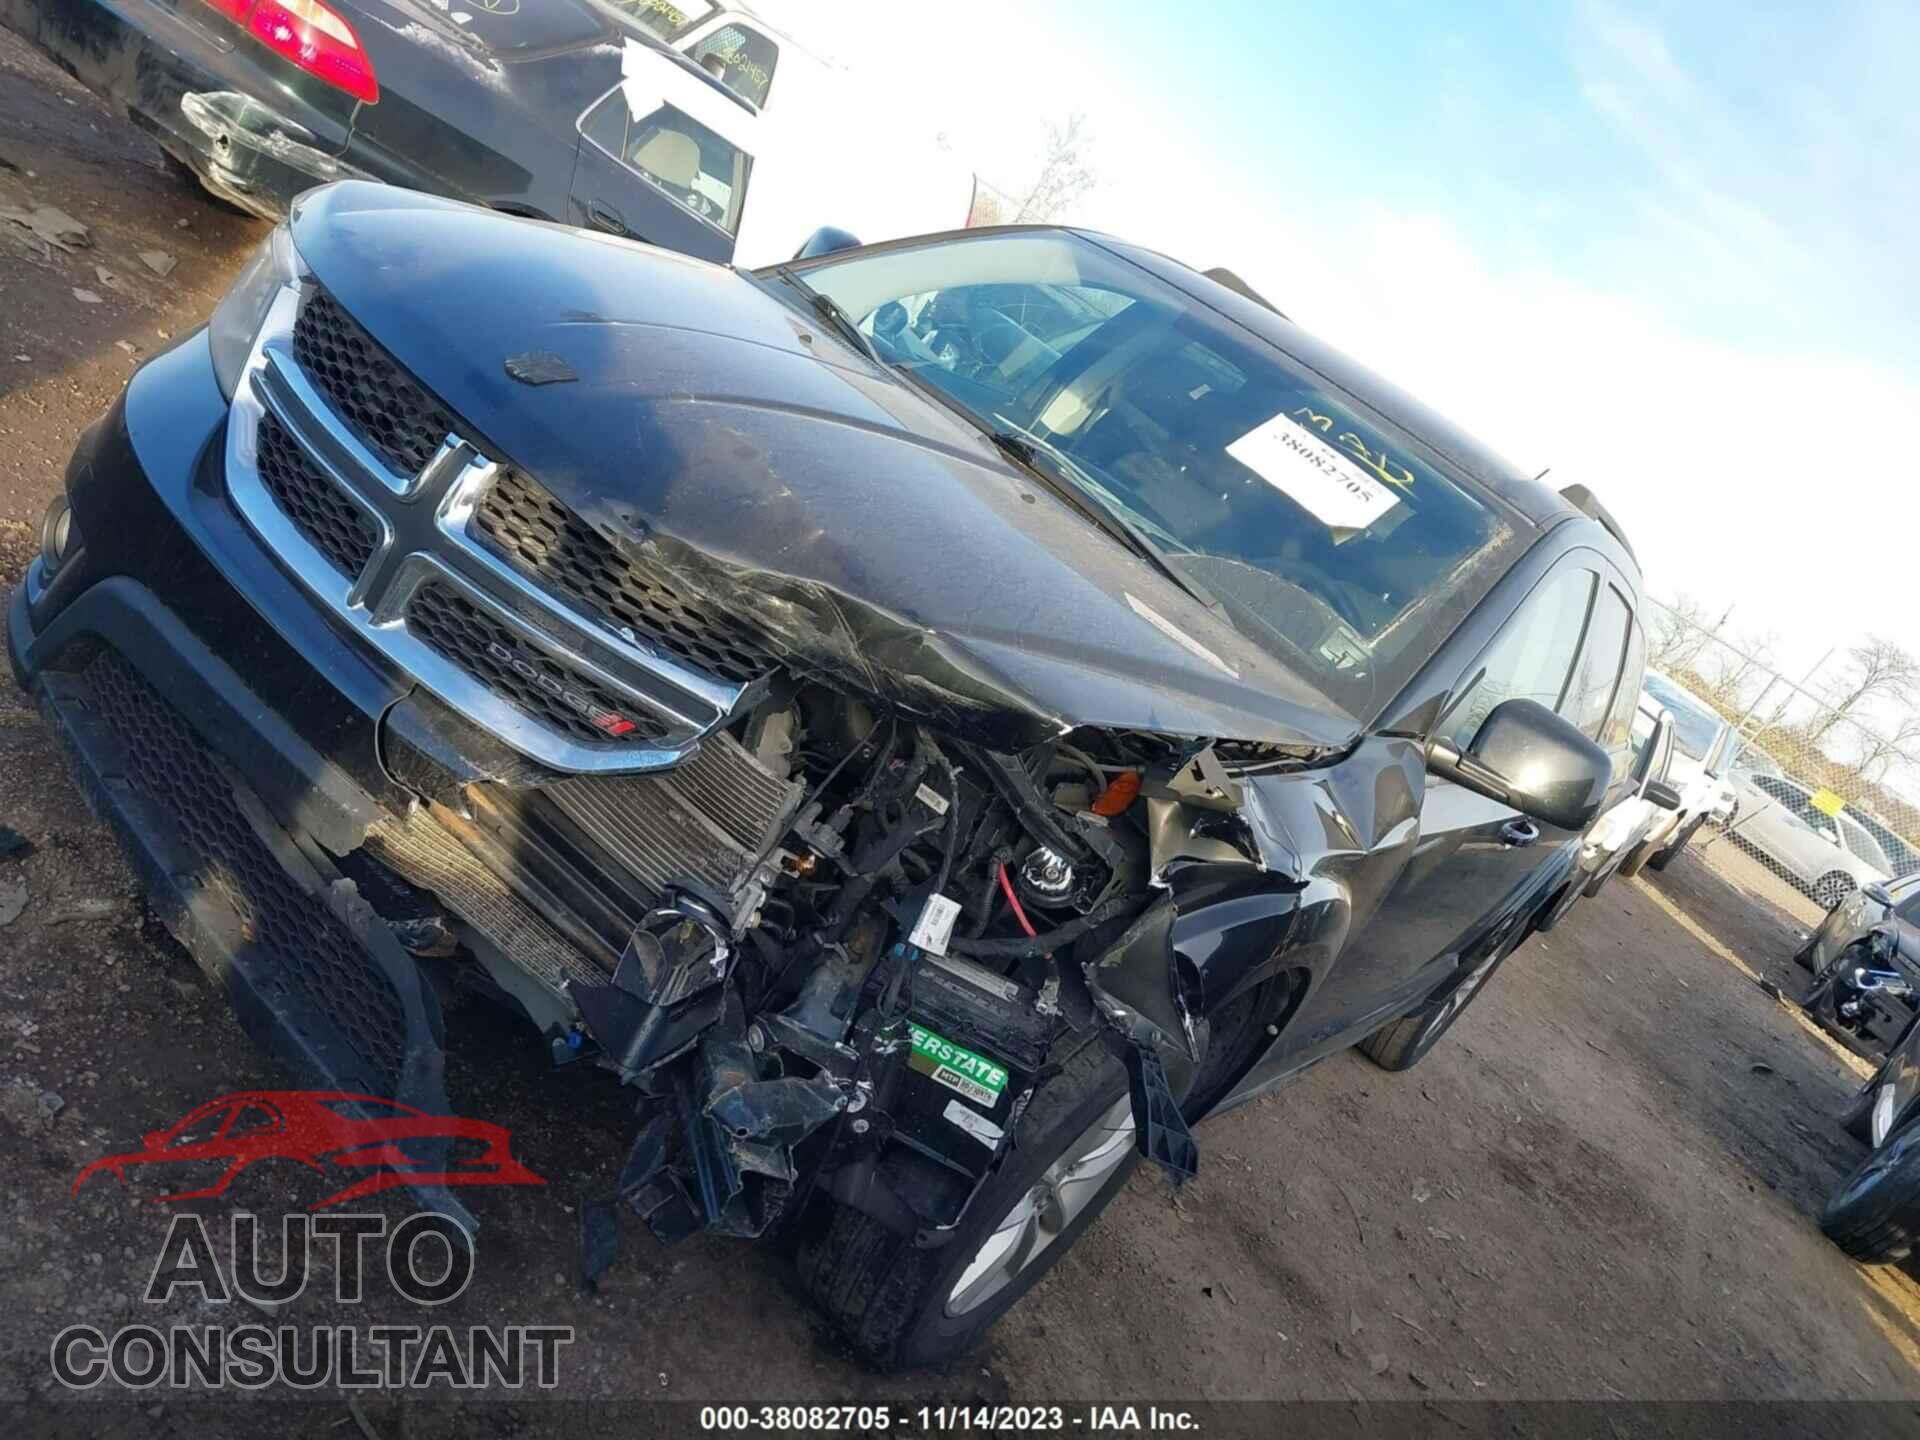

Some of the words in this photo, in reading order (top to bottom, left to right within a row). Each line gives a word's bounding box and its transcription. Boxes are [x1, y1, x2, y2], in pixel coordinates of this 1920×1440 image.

[1275, 432, 1374, 502] 38082705
[485, 641, 620, 727] DODGE
[908, 1026, 1005, 1086] ERSTATE
